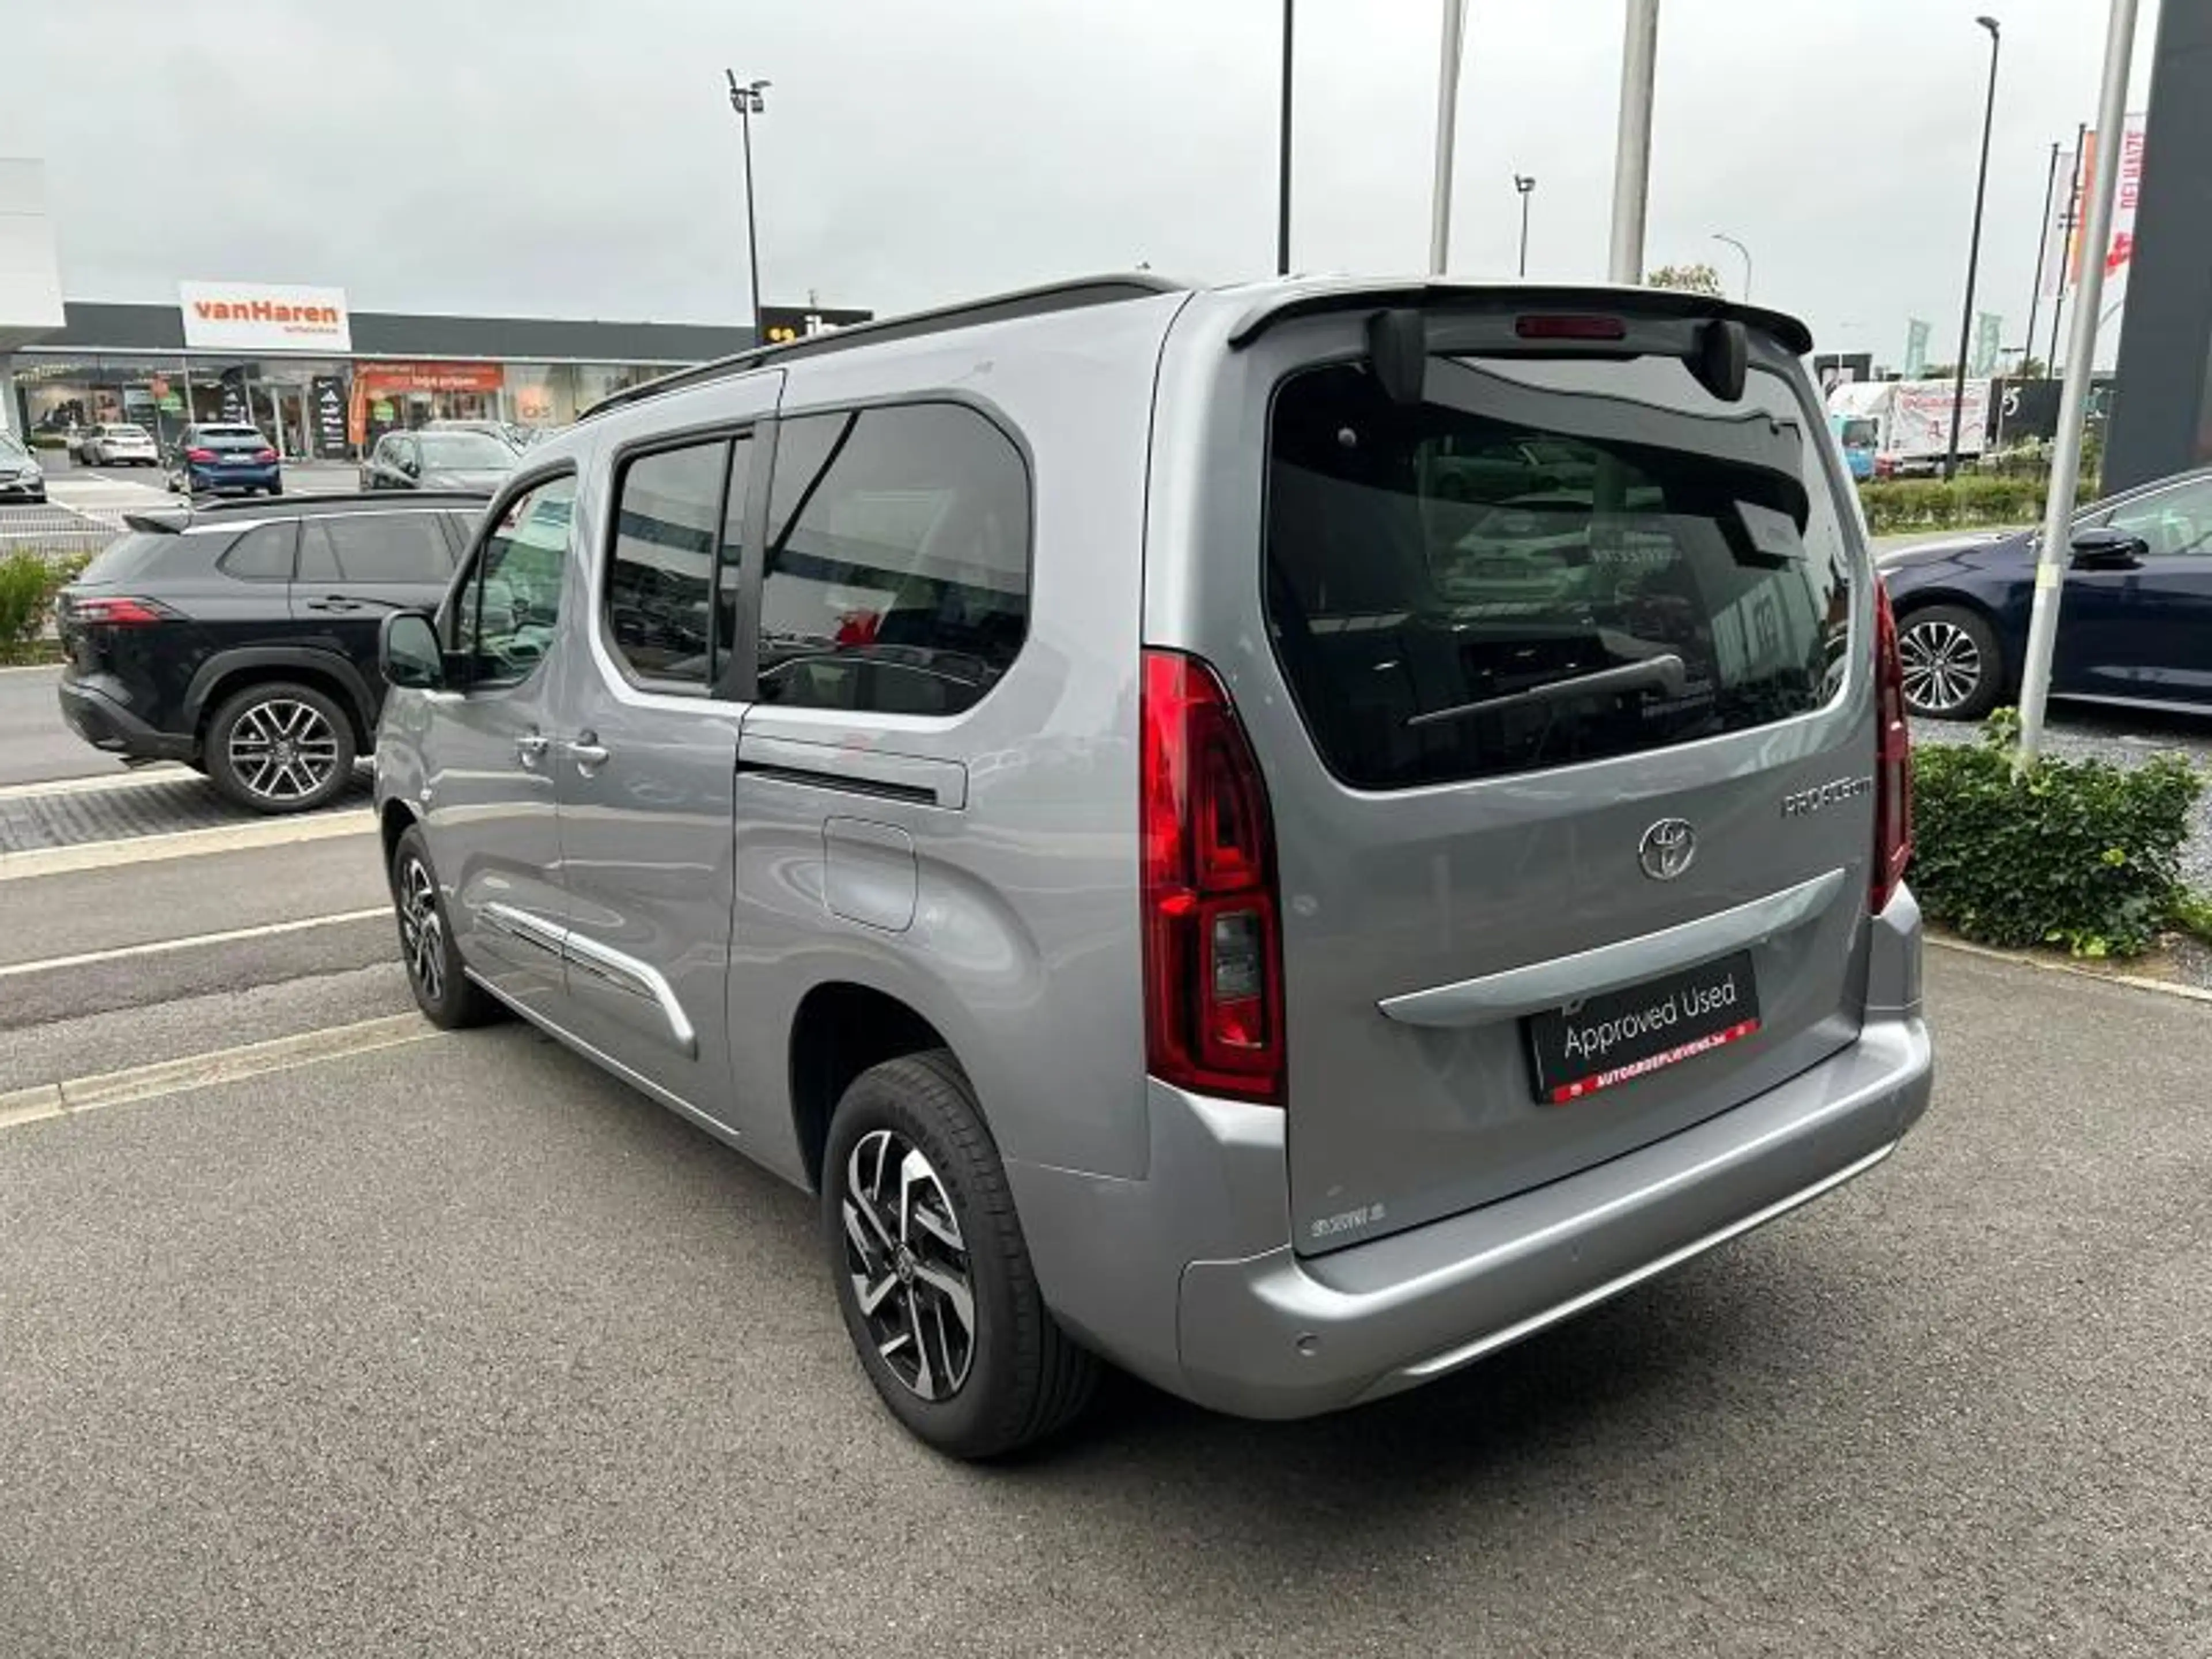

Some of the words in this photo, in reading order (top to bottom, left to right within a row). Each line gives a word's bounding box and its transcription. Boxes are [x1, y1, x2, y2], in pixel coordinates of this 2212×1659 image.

[194, 300, 339, 323] vanHaren
[1564, 995, 1678, 1060] Approved
[1683, 973, 1737, 1017] Used
